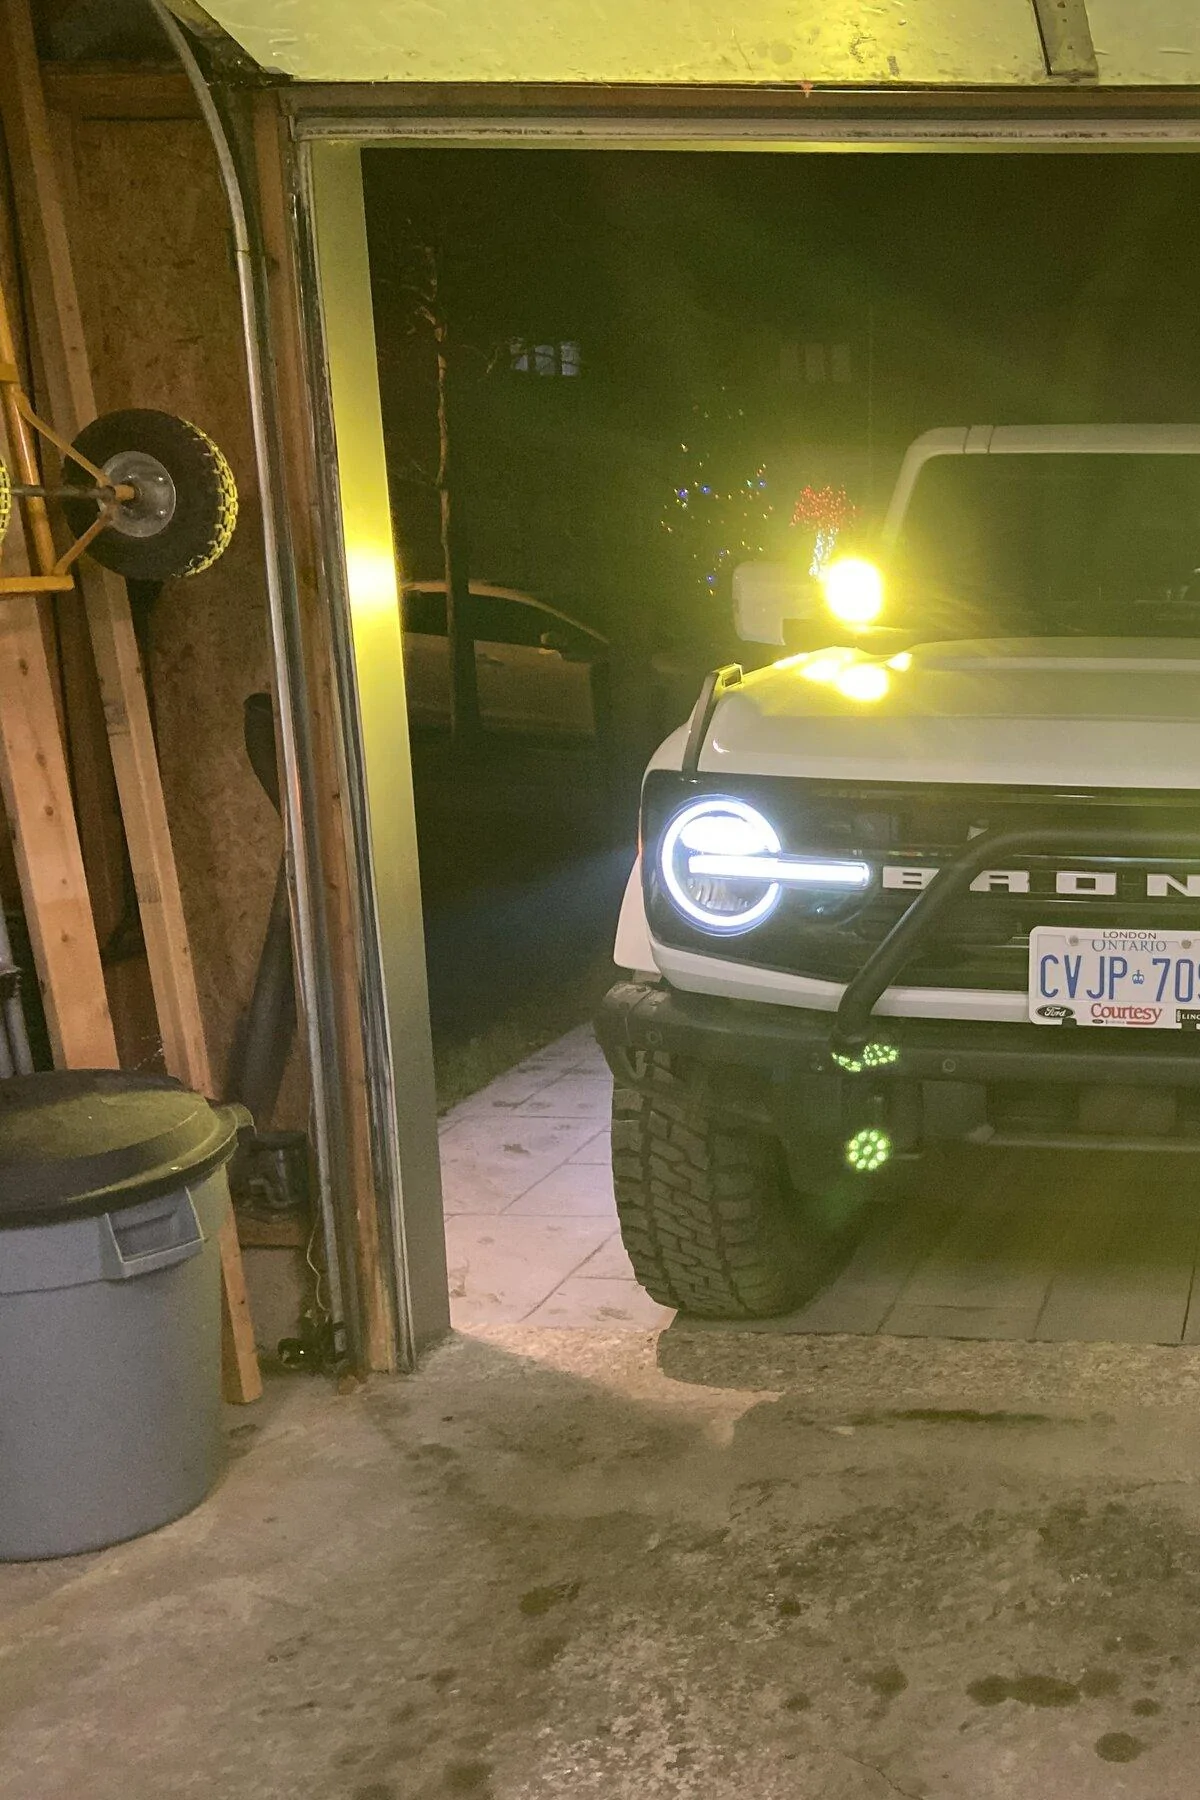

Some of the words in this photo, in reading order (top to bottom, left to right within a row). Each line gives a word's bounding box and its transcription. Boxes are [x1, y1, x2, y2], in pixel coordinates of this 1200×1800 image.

[1103, 931, 1157, 940] LONDON
[1091, 938, 1167, 952] ONTARIO
[1040, 954, 1128, 1000] CVJP
[1091, 1003, 1163, 1022] Courtesy
